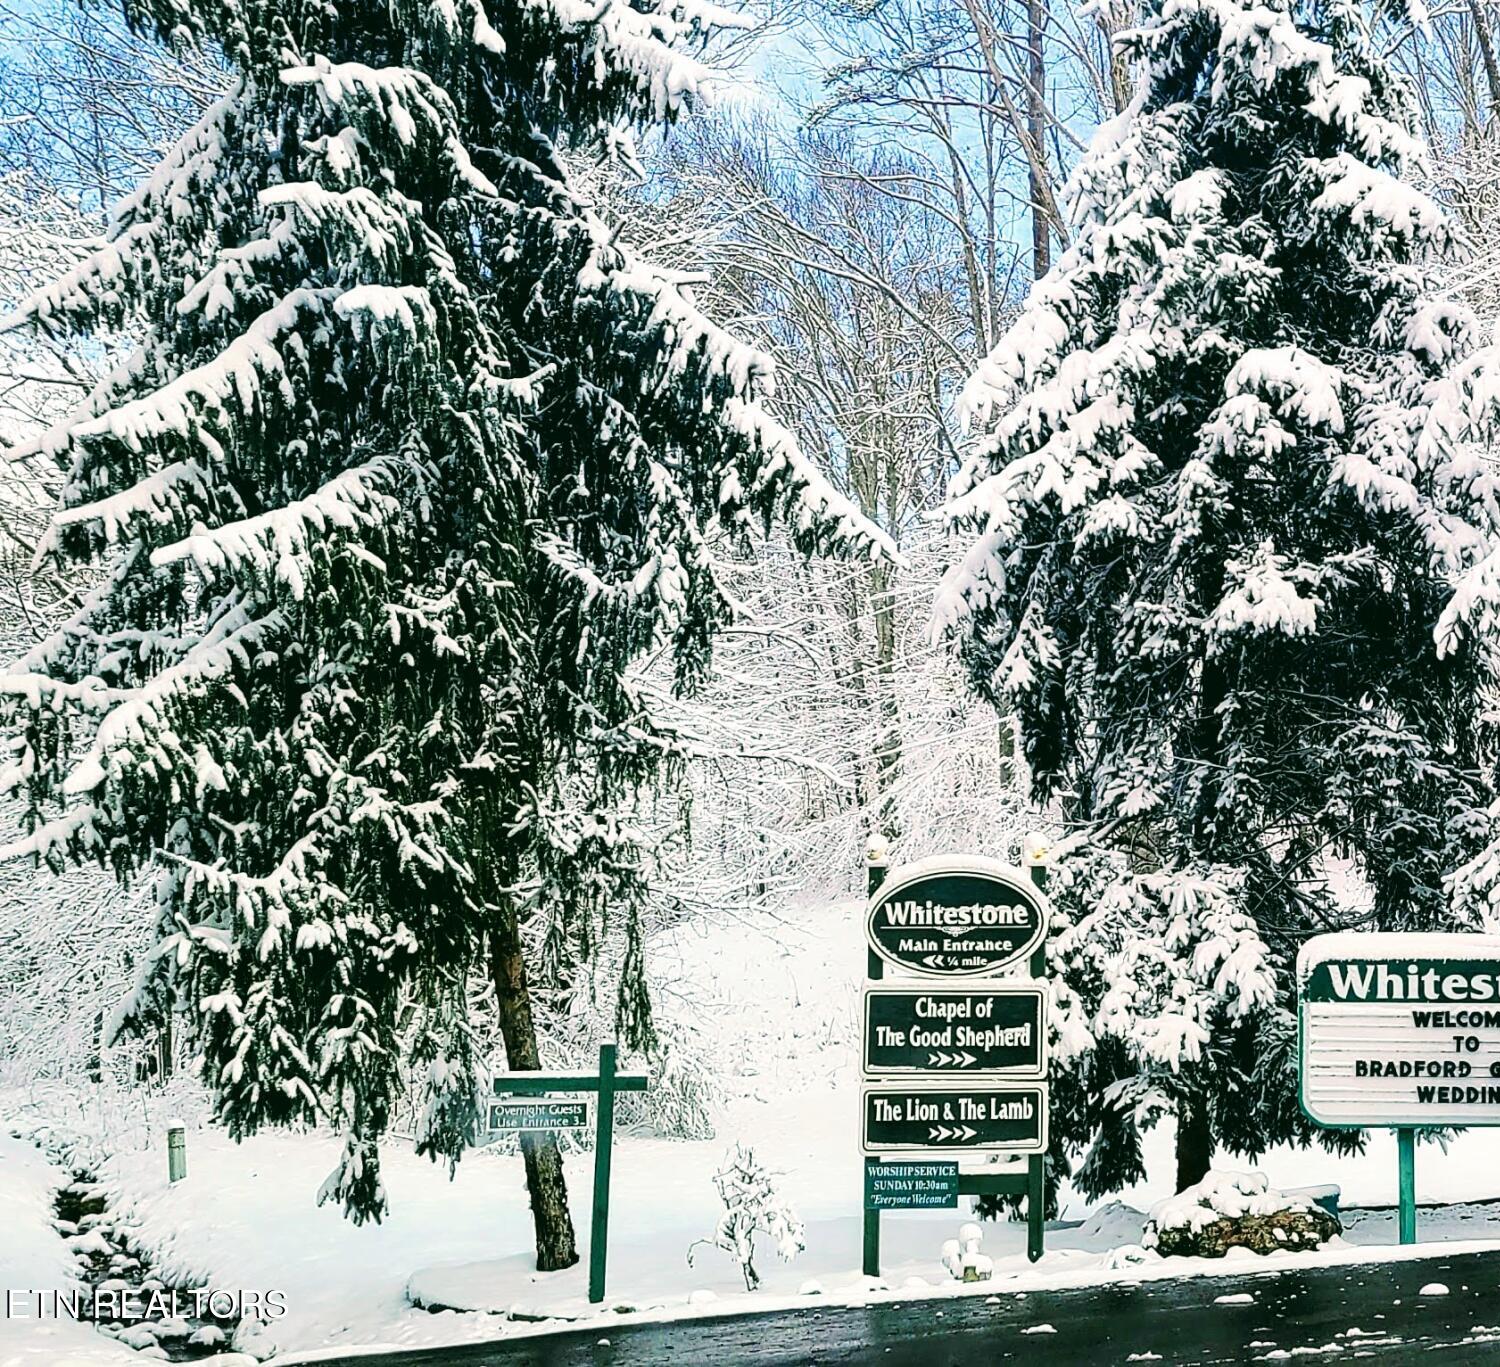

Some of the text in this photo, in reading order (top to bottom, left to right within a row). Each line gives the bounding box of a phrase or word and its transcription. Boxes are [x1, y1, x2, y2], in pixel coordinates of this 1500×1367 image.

[884, 901, 1029, 926] Whitestone
[898, 938, 1013, 952] Main Entrance
[961, 957, 988, 967] mile
[915, 997, 994, 1023] Chapel of
[876, 1023, 1031, 1052] The Good Shepherd
[1453, 1036, 1480, 1053] TO
[1355, 1061, 1472, 1078] BRADFORD
[494, 1104, 583, 1118] Overnight Guests
[873, 1097, 1034, 1121] The Lion & The Lamb
[497, 1118, 518, 1128] Use
[522, 1117, 570, 1127] Entrance
[867, 1166, 956, 1176] WORSHIP SERVICE
[873, 1180, 949, 1190] SUNDAY 10:30am
